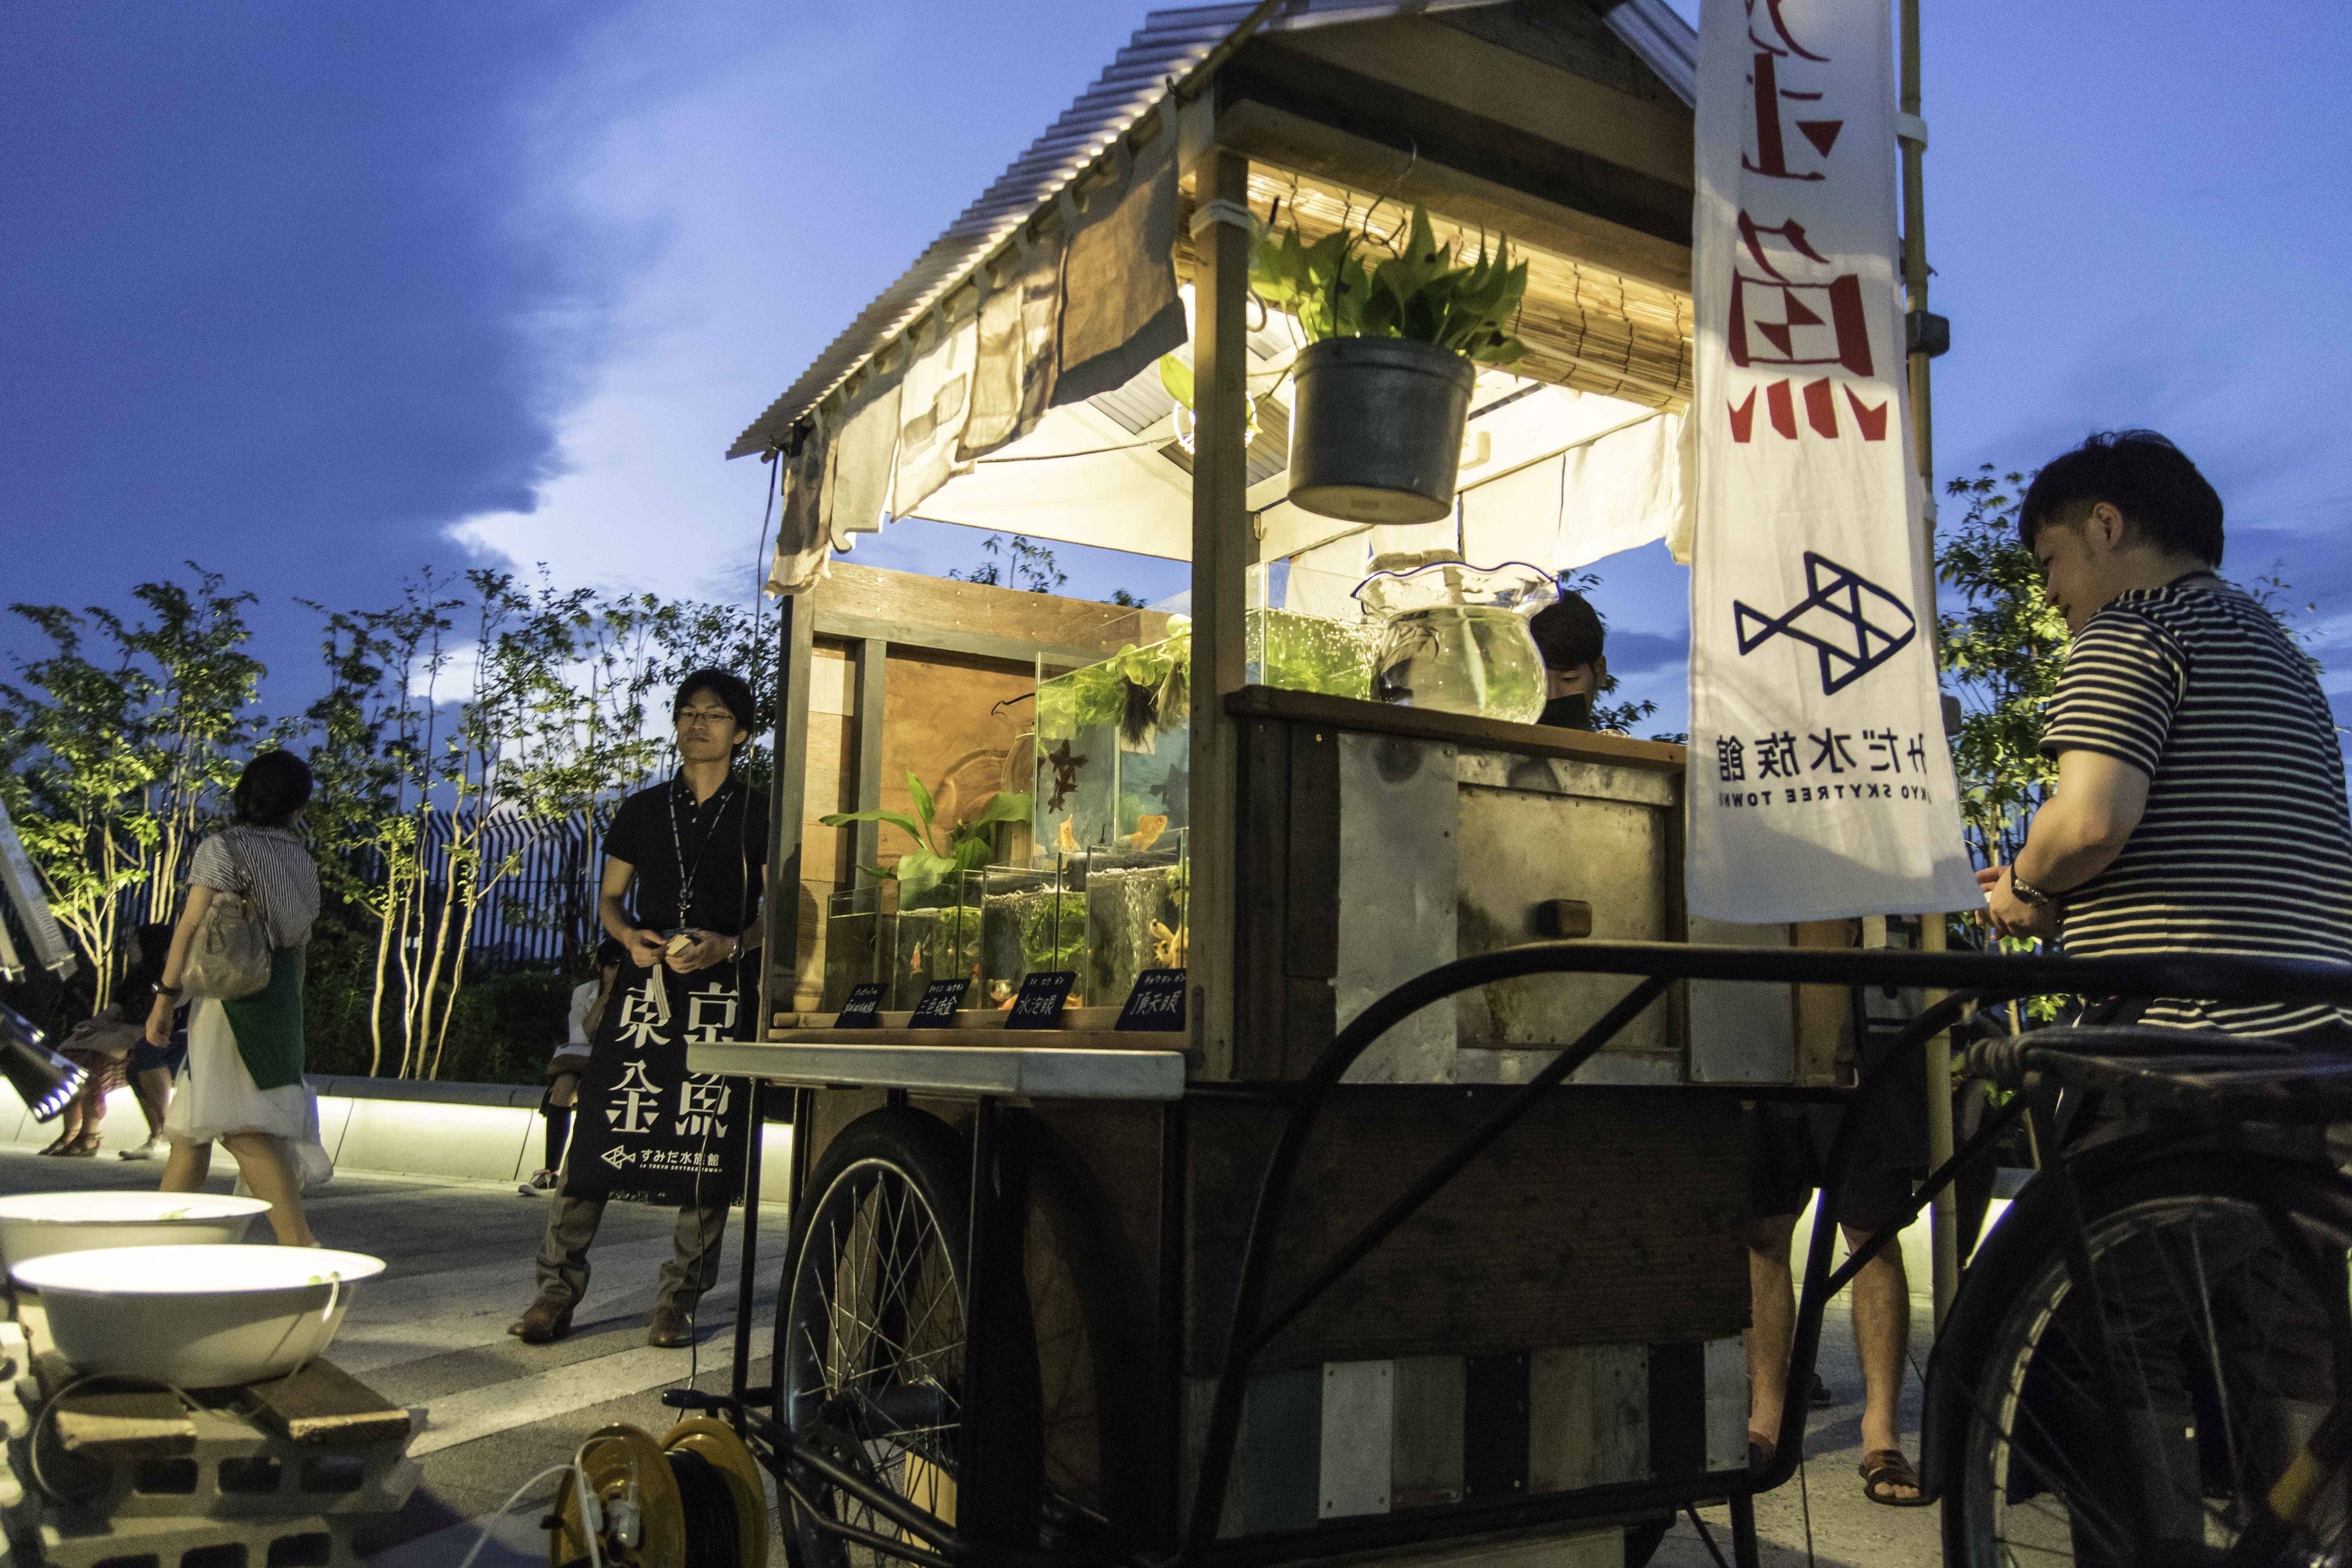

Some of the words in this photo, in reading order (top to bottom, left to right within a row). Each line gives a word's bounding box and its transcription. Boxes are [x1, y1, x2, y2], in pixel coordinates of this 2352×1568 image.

[1016, 994, 1057, 1016] 水泡眼
[1130, 990, 1182, 1016] 頂天眼
[640, 1148, 720, 1166] すみだ水族館
